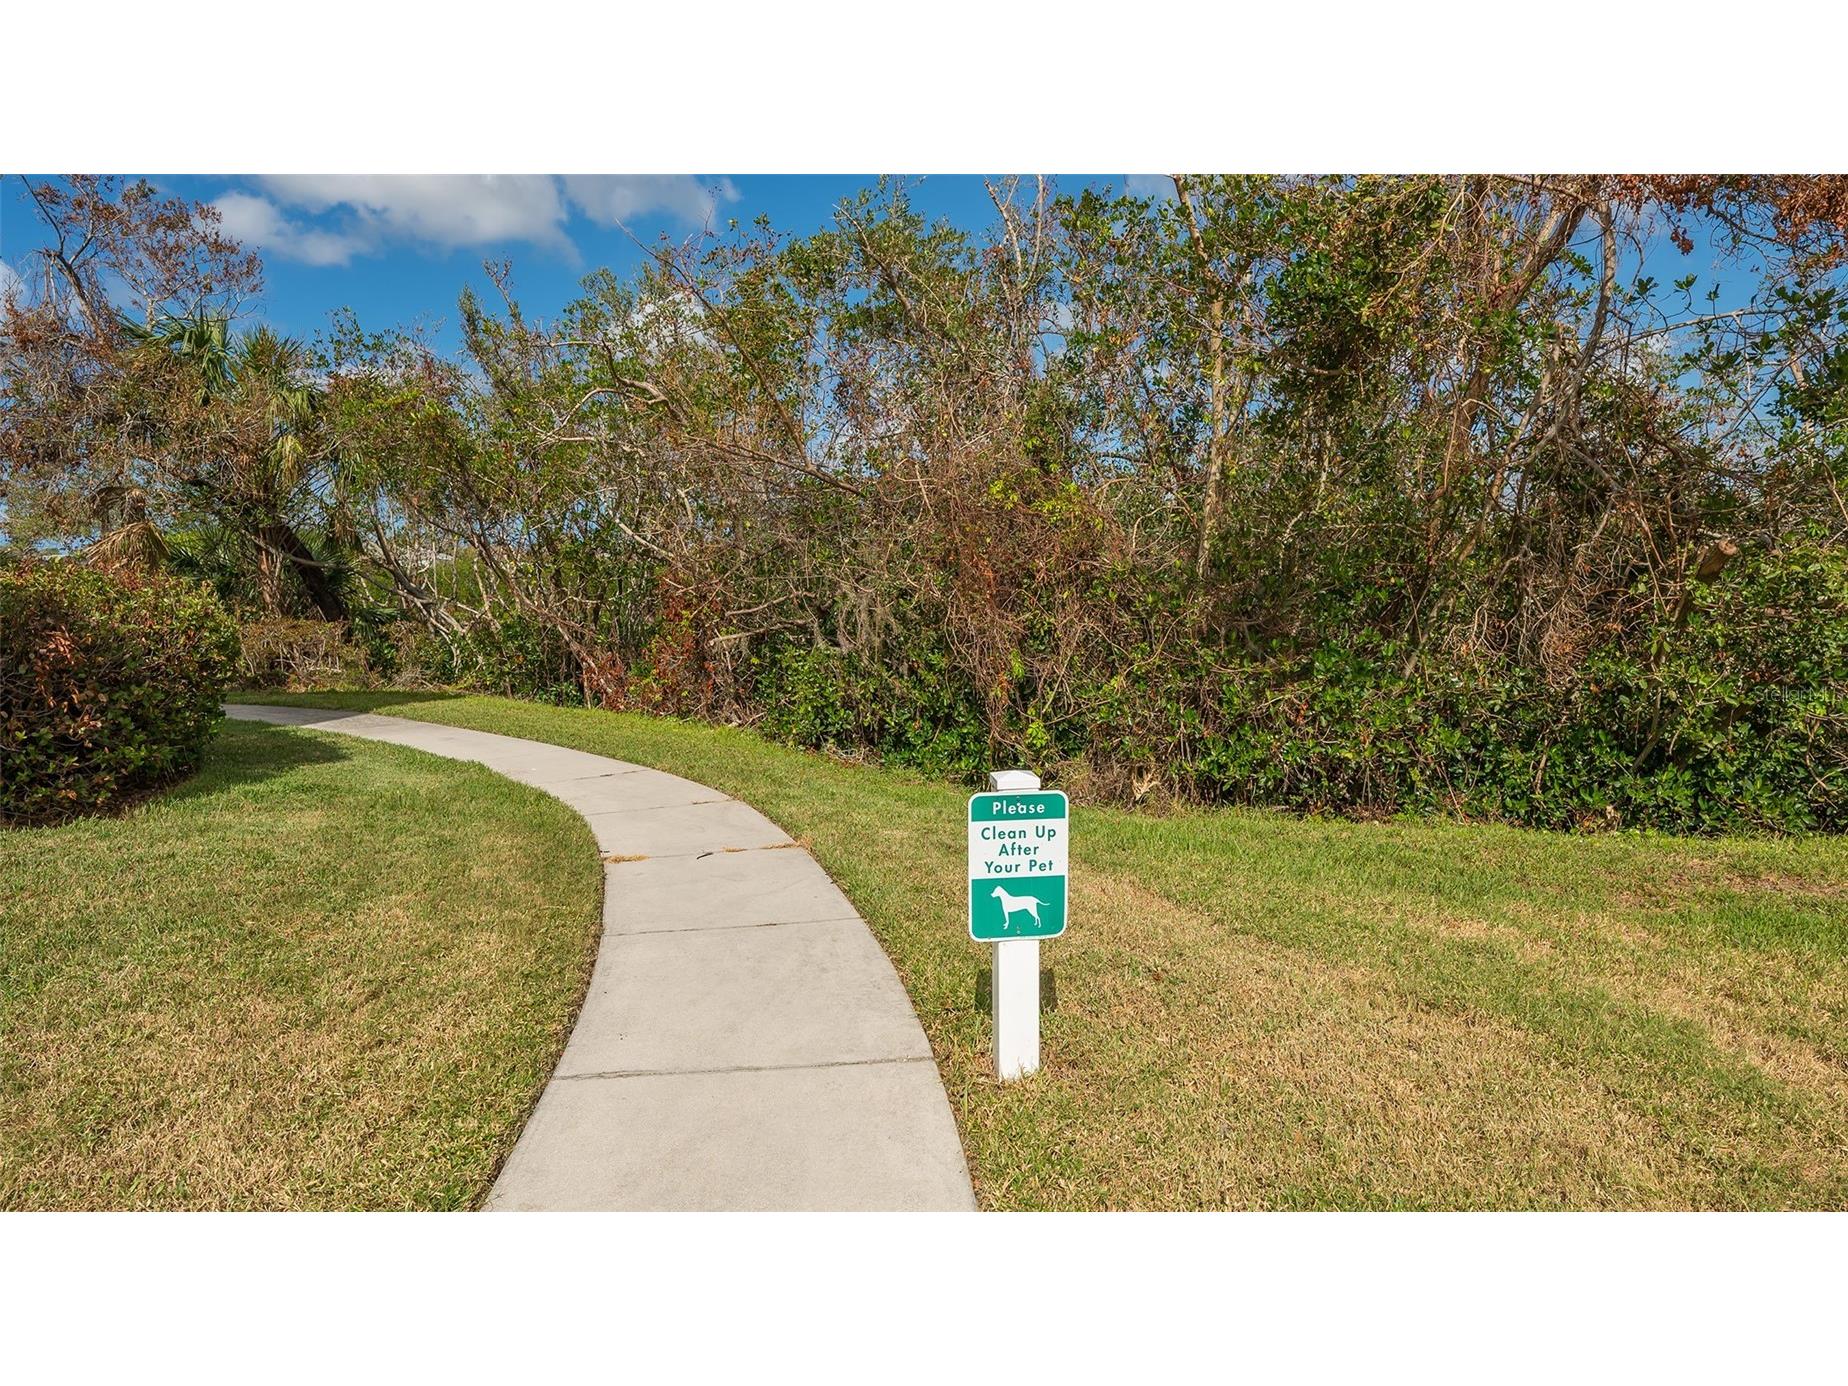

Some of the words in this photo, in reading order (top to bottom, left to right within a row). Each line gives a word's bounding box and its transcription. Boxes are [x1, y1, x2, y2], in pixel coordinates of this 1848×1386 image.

[992, 800, 1045, 815] Please
[981, 825, 1027, 840] Clean
[1035, 825, 1056, 841] Up
[998, 842, 1039, 856] After
[984, 861, 1021, 874] Your
[1029, 859, 1053, 872] Pet
